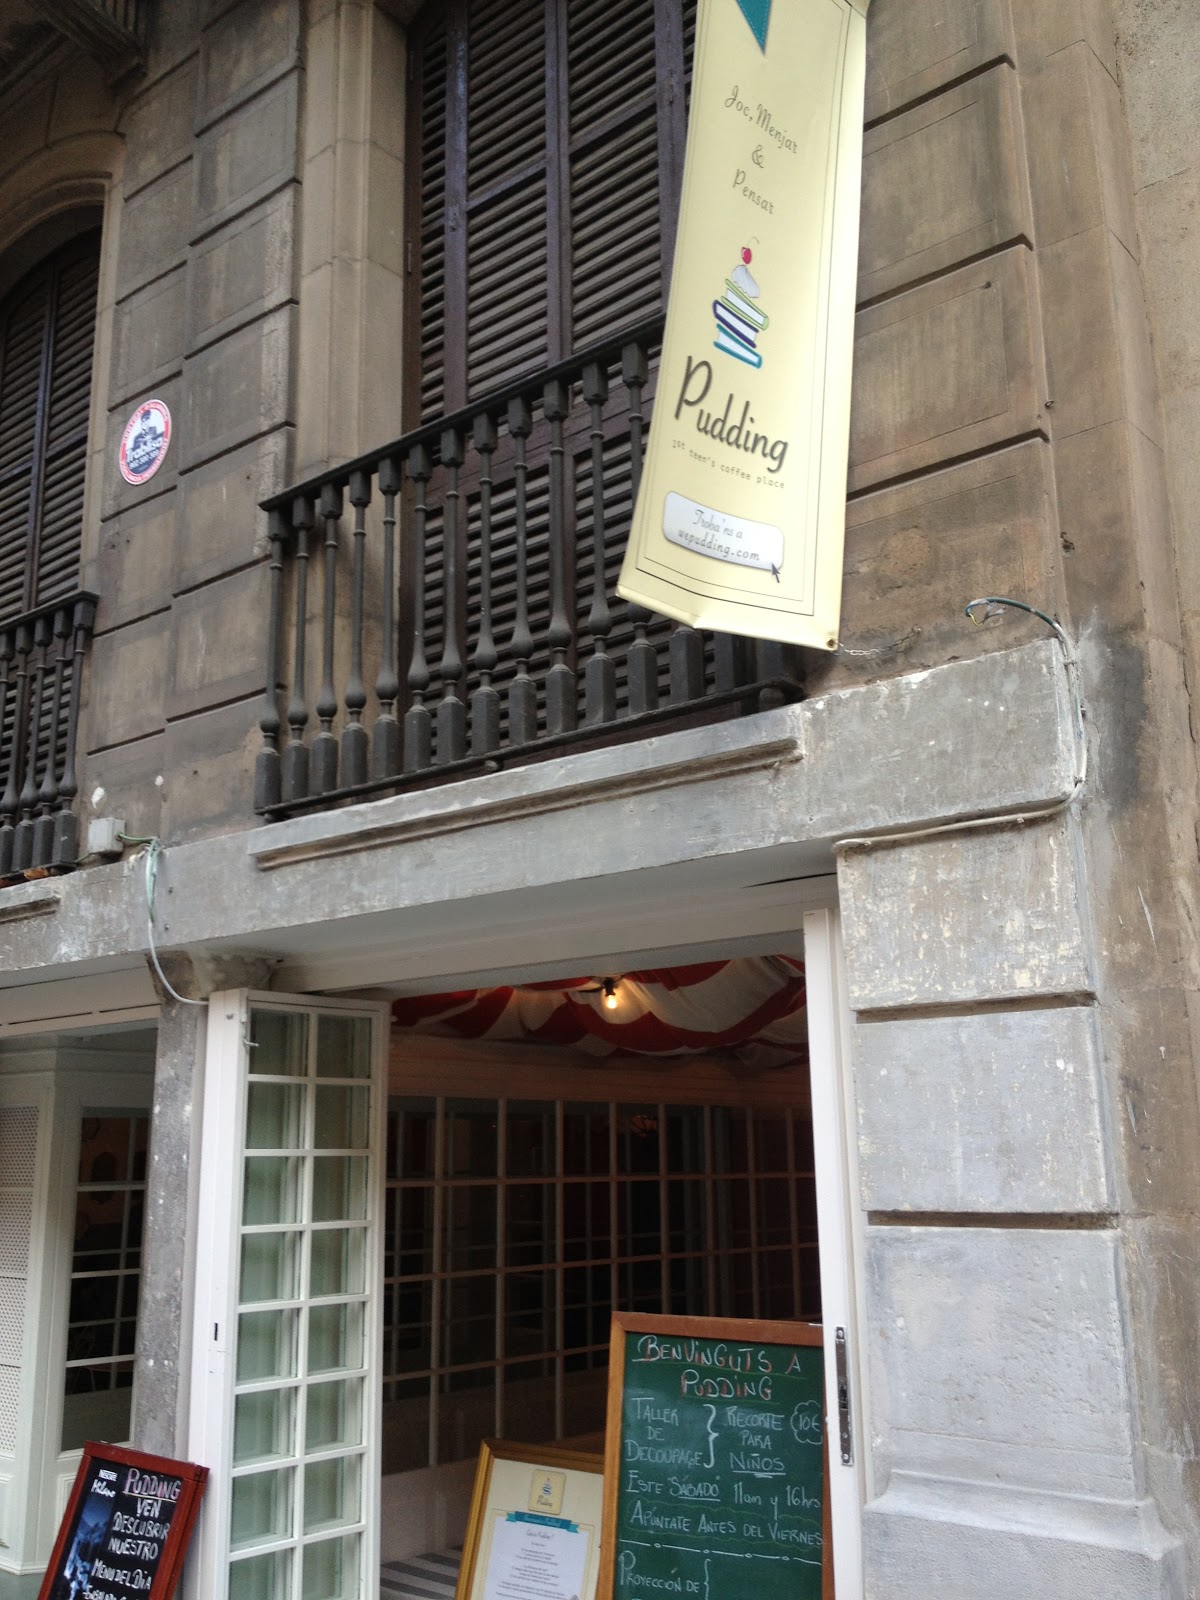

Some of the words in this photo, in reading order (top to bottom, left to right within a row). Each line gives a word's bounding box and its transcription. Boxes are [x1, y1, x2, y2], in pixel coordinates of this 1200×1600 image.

[724, 85, 753, 122] Joc,
[756, 103, 798, 153] Menjar
[751, 144, 765, 168] &
[732, 168, 775, 214] Pensar
[674, 355, 789, 474] Pudding
[689, 447, 716, 468] teen's
[720, 462, 752, 481] coffee
[756, 474, 785, 489] place
[677, 526, 760, 561] wepudding.com
[785, 1353, 801, 1374] A
[647, 1426, 664, 1440] DE
[741, 1430, 772, 1450] PARA
[626, 1470, 663, 1493] ESTE
[771, 1496, 778, 1520] y
[698, 1513, 736, 1534] ANTES
[743, 1523, 764, 1538] DEL
[768, 1522, 823, 1546] VIERNES
[108, 1537, 159, 1561] NUESTRO
[686, 1580, 700, 1593] DE
